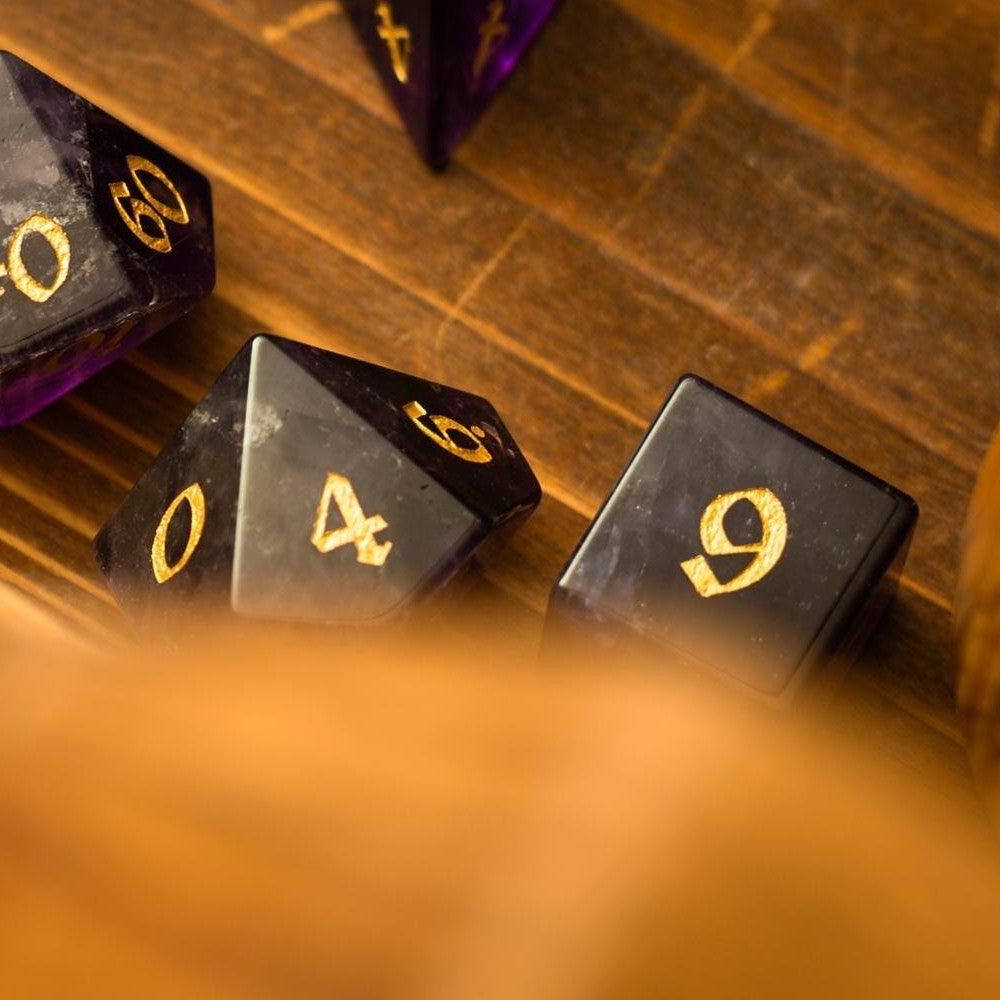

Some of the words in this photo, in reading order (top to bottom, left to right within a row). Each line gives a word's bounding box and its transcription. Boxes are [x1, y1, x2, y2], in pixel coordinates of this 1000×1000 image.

[107, 153, 191, 256] 60
[150, 480, 208, 584] 0
[309, 470, 393, 568] 4
